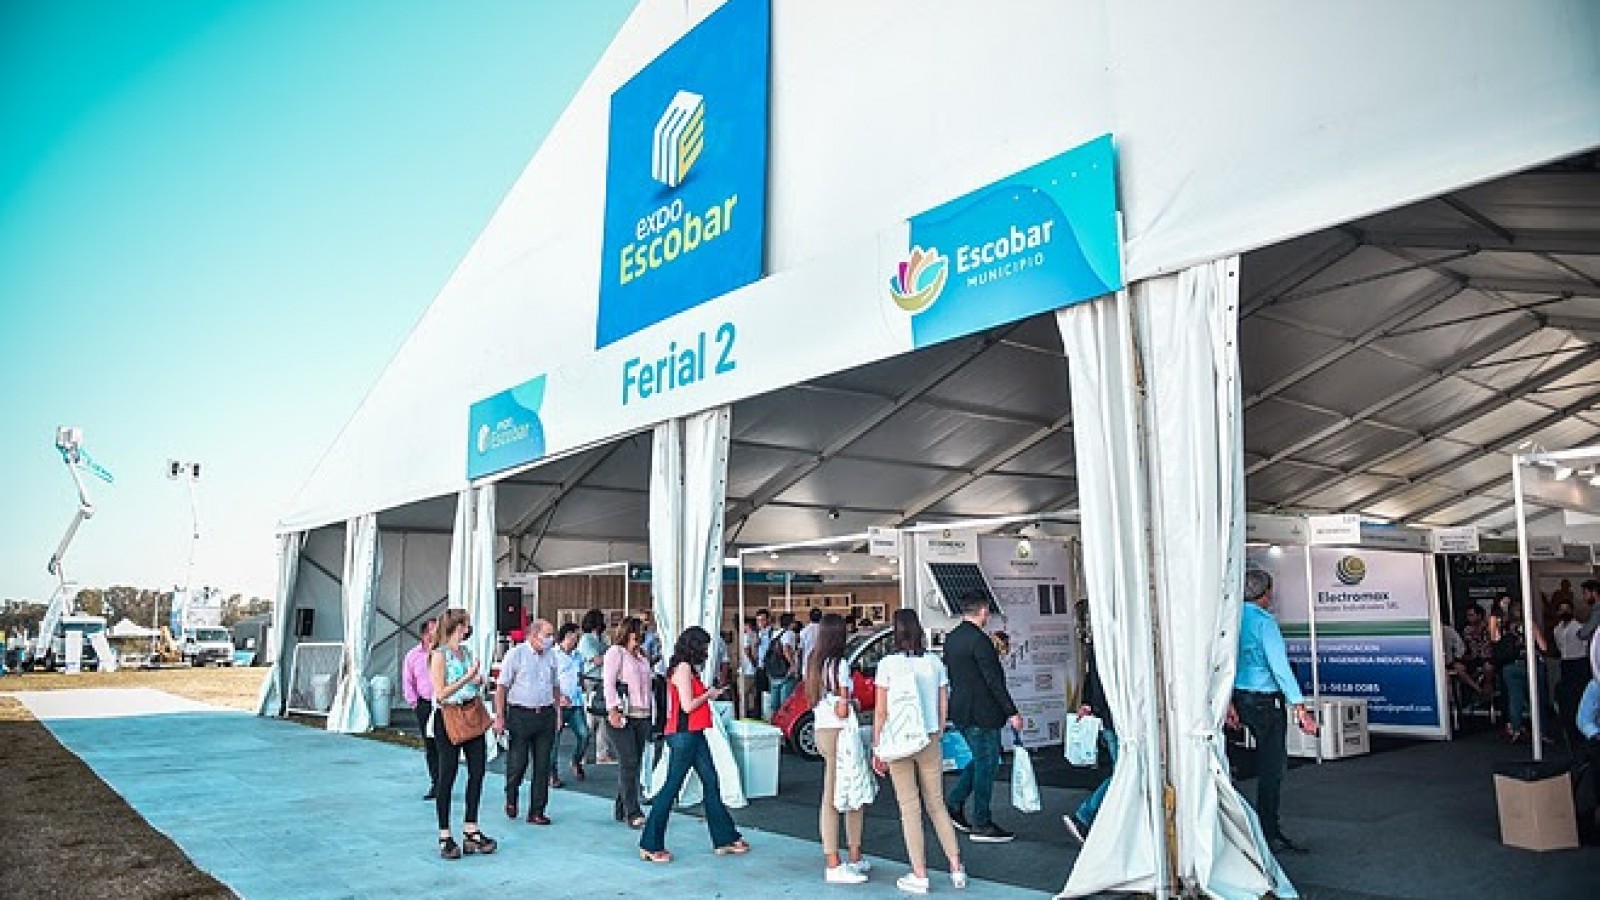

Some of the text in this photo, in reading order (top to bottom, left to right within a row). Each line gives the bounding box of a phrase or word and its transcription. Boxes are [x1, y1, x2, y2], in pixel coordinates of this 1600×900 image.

[619, 193, 738, 286] Escobar
[636, 199, 684, 241] expo
[956, 220, 1054, 273] Escobar
[966, 251, 1045, 287] MUNICIPIO
[622, 321, 736, 406] Ferial 2
